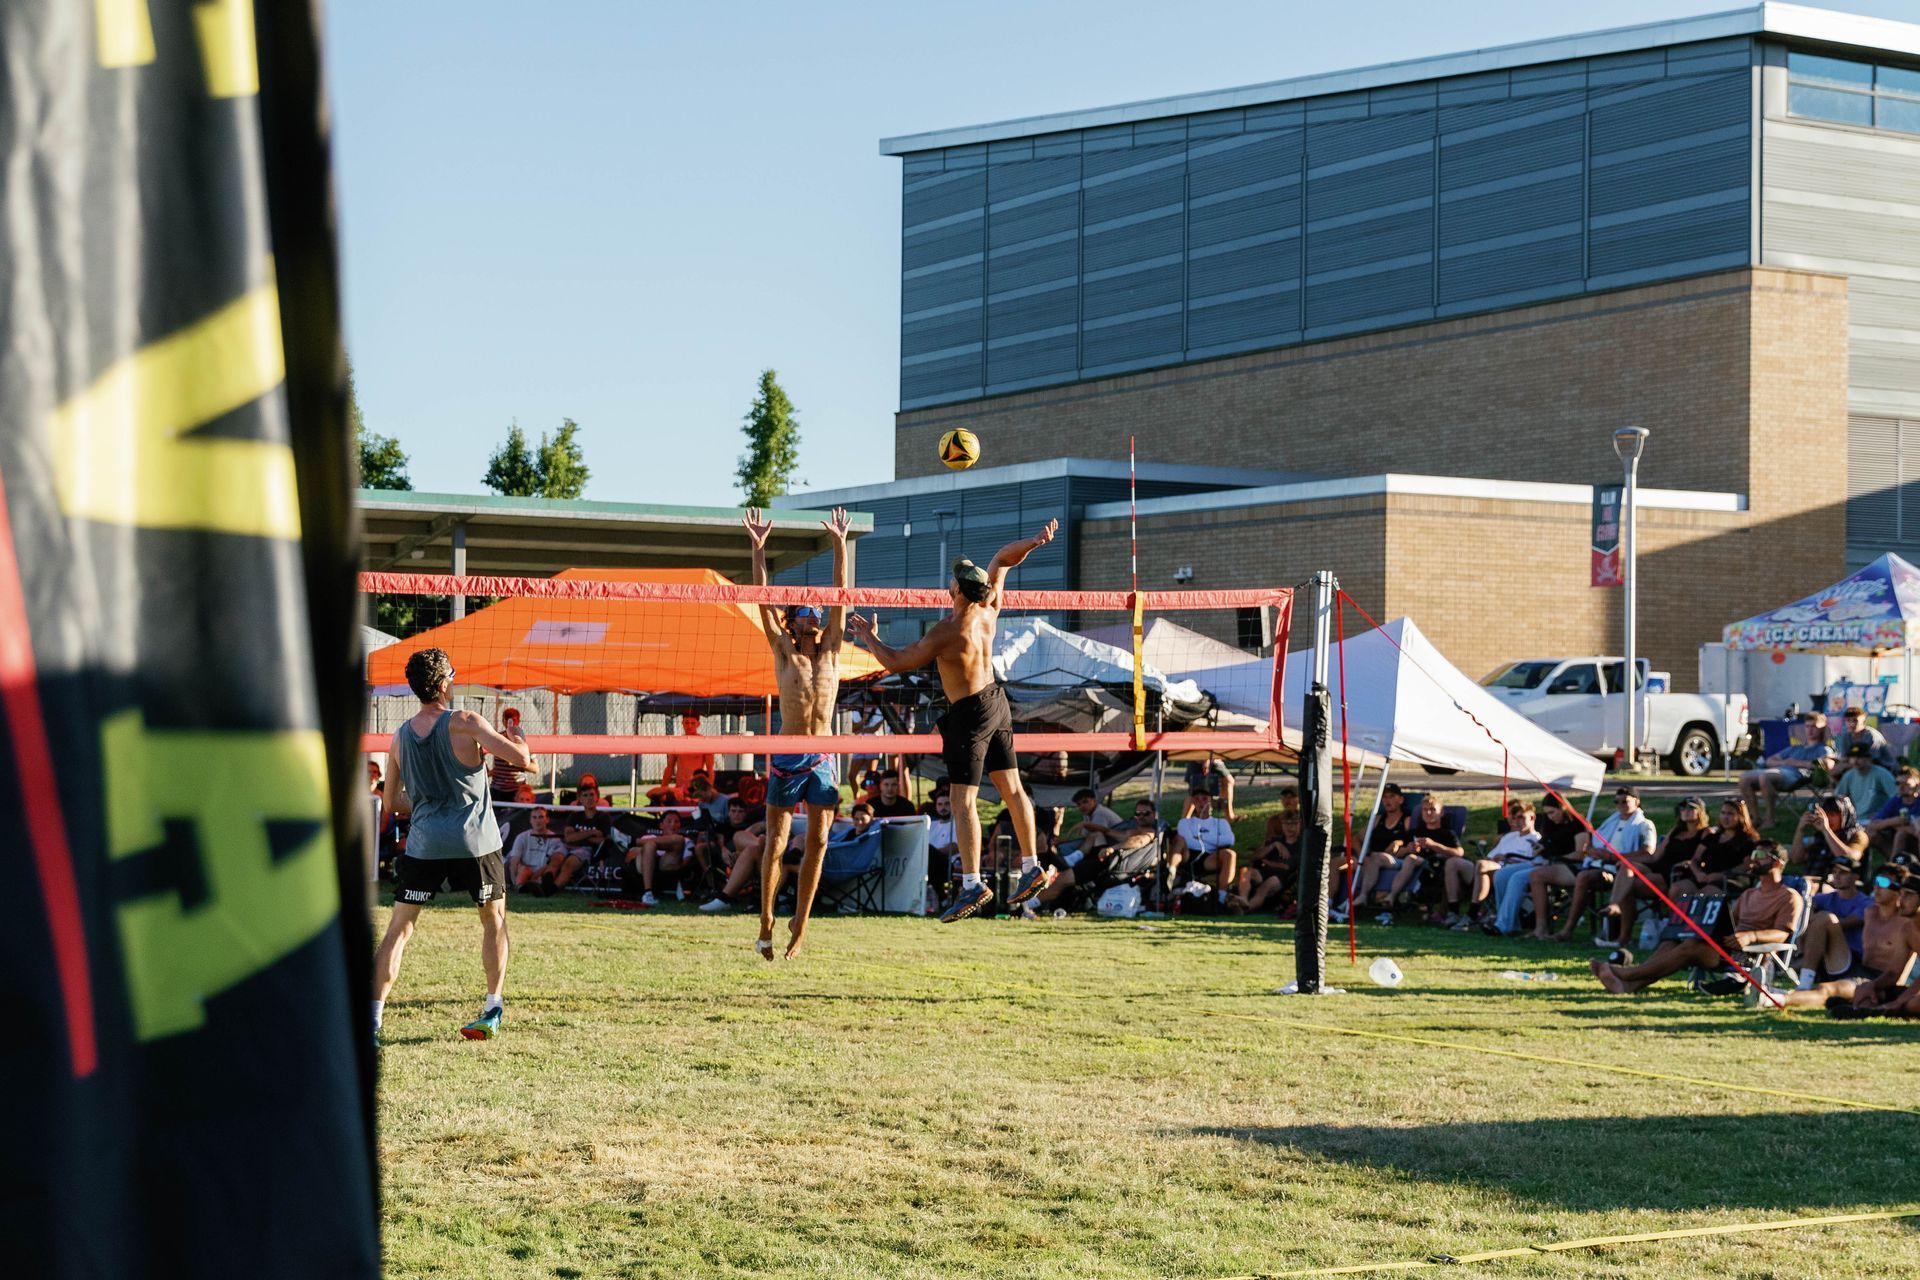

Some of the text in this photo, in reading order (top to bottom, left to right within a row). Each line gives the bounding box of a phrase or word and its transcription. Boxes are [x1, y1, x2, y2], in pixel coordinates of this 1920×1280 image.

[1765, 626, 1861, 643] ICE CREAM
[1702, 900, 1723, 925] 13
